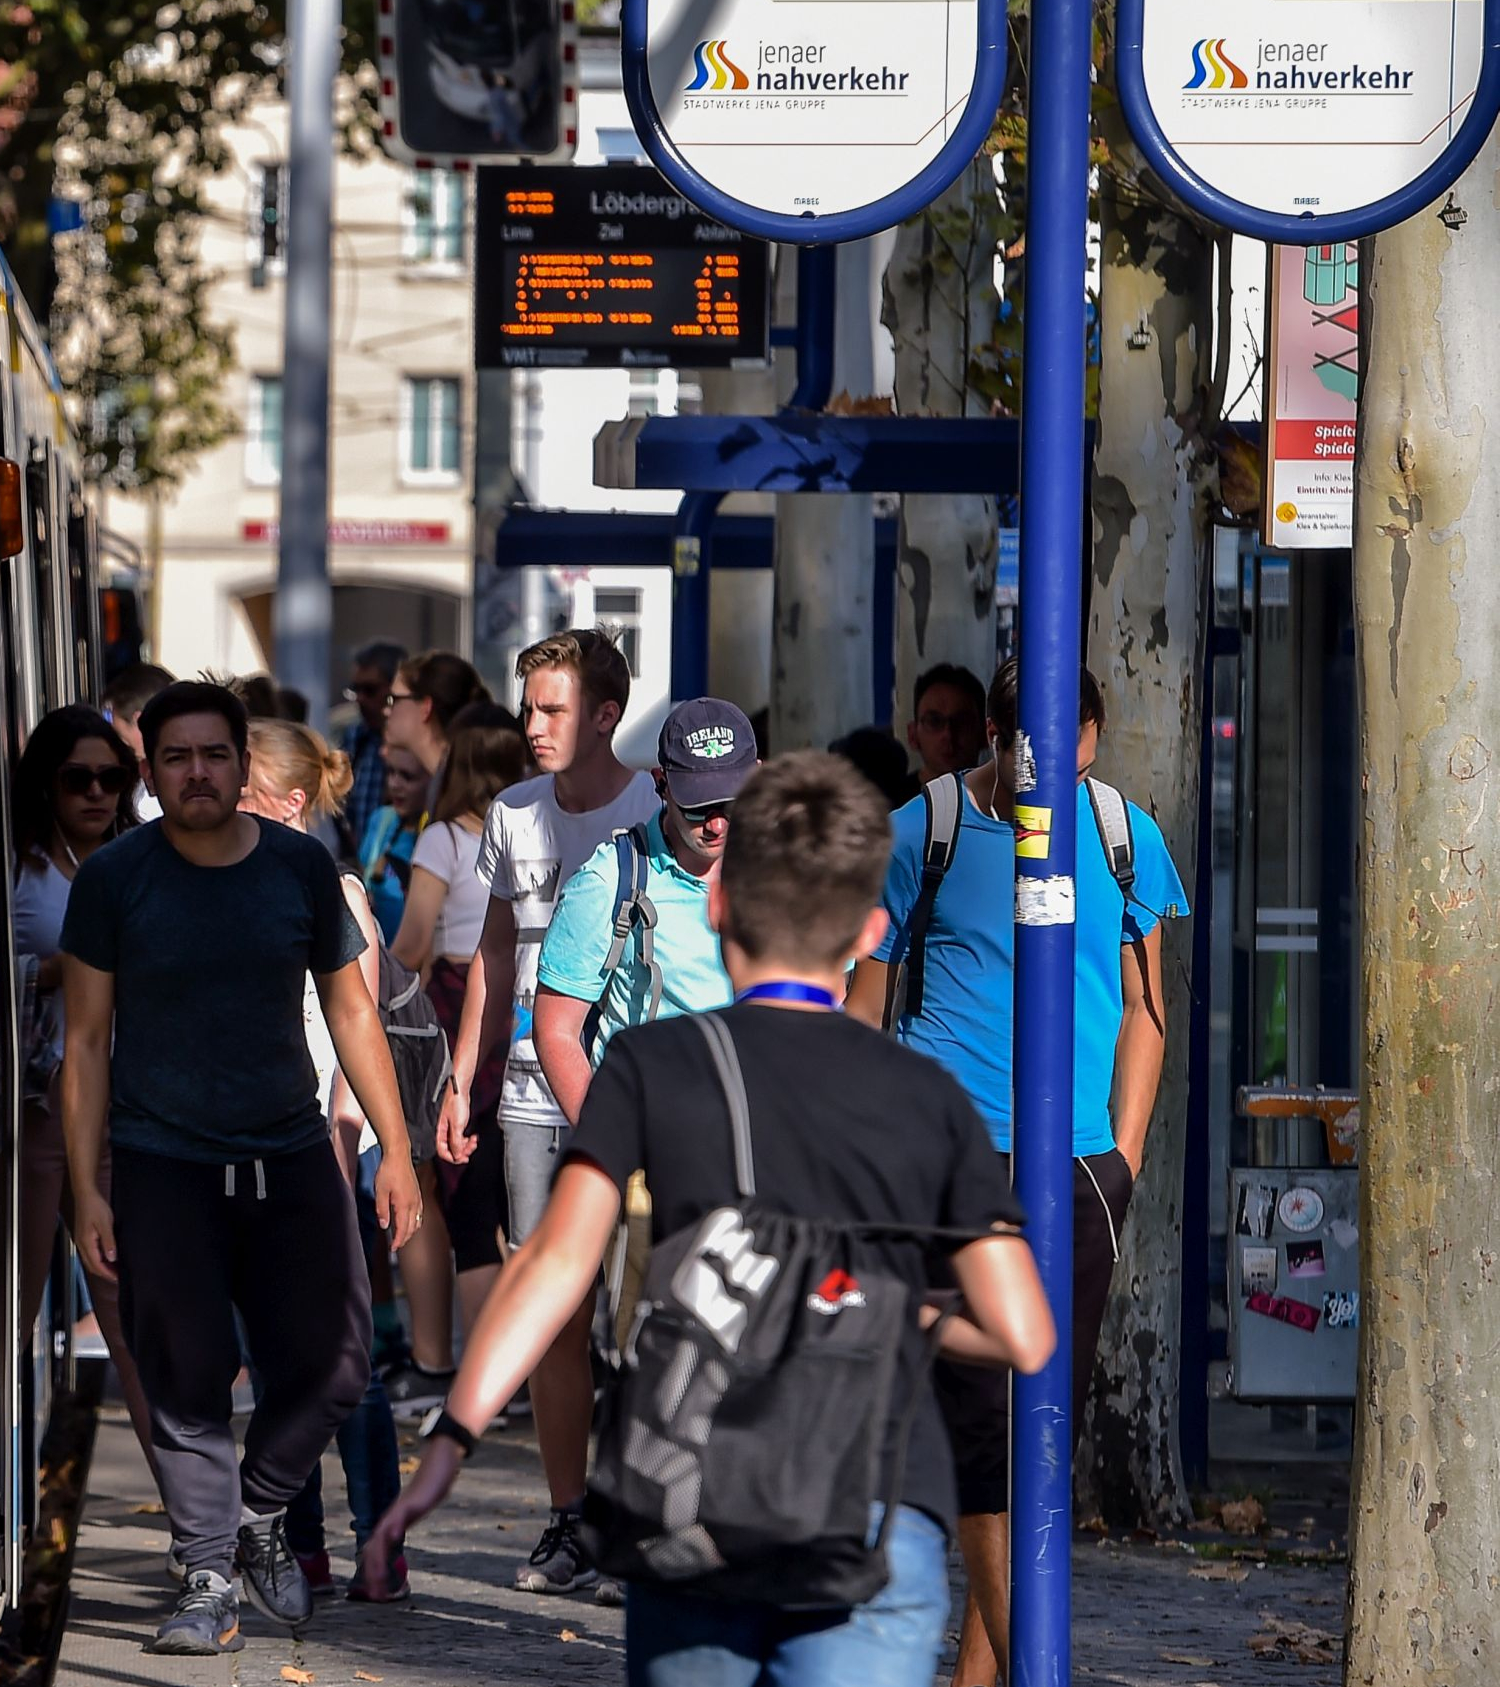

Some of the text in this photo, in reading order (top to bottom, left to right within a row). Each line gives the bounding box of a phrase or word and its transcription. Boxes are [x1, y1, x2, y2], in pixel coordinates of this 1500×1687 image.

[757, 40, 827, 70] jenaer
[1257, 39, 1328, 68] jenaer
[757, 66, 910, 91] nahverkehr
[1256, 64, 1414, 90] nahverkehr
[683, 100, 826, 110] STADTWERKE JENA GRUPPE
[598, 223, 624, 241] Ziel
[1297, 486, 1328, 495] Eintritt:
[686, 726, 734, 748] IRELAND
